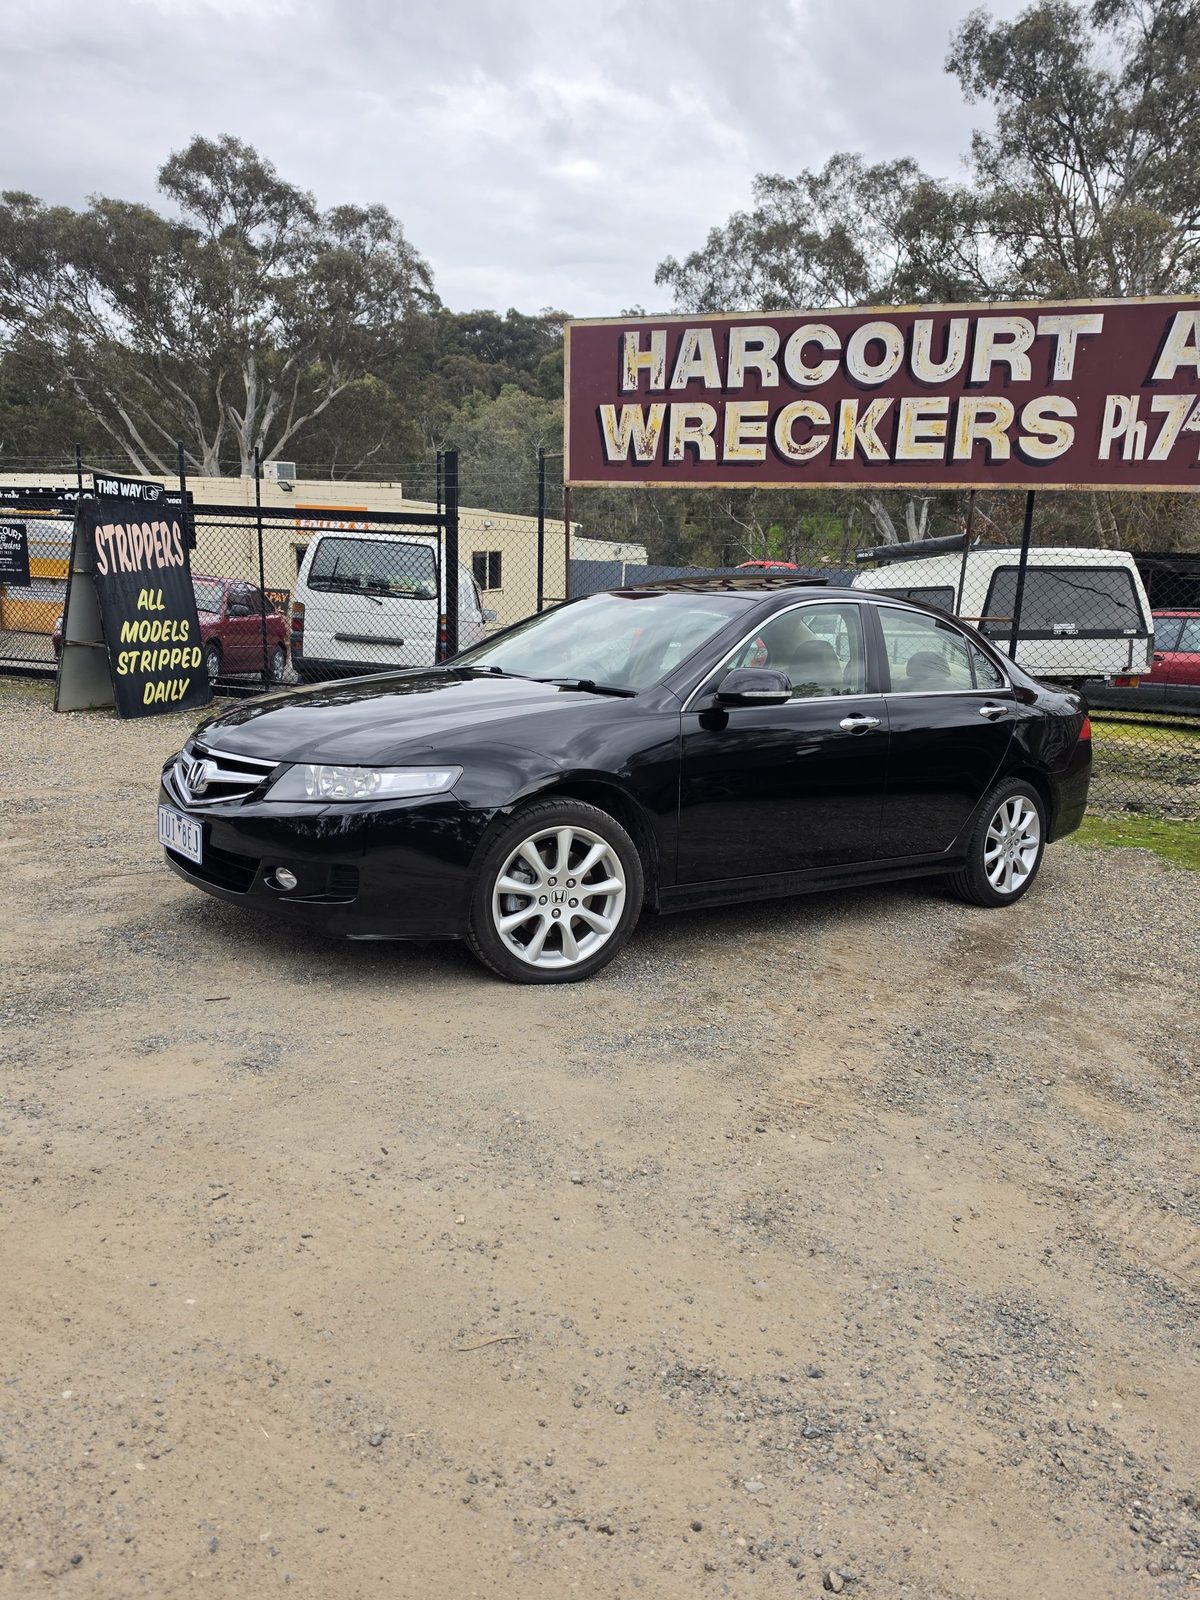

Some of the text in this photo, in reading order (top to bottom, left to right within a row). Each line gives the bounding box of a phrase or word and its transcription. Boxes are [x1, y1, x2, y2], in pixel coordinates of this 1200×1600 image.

[622, 314, 1104, 390] HARCOURT
[600, 395, 1078, 462] WRECKERS
[96, 479, 142, 498] THIS WAY
[95, 521, 184, 576] STRIPPERS
[137, 588, 166, 611] ALL
[120, 619, 189, 644] MODELS
[116, 647, 202, 675] STRIPPED
[142, 677, 190, 706] DAILY
